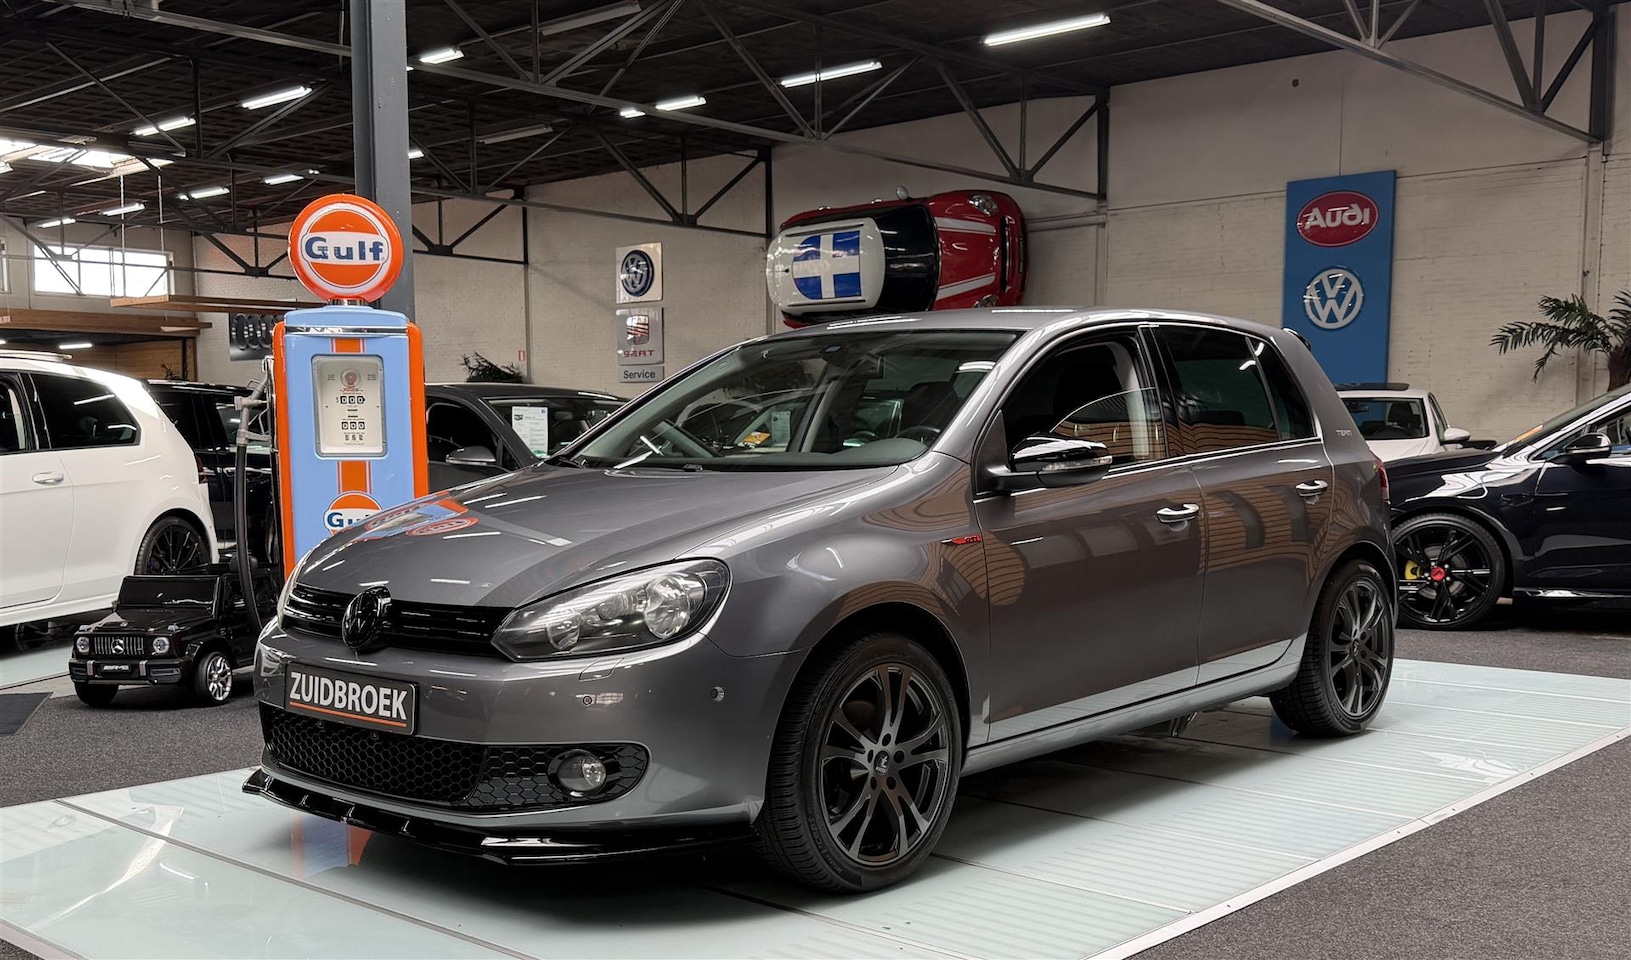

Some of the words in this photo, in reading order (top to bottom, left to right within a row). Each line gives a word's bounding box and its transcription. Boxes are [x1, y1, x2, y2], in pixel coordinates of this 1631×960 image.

[1304, 203, 1371, 230] Audi
[304, 236, 385, 262] Gulf
[623, 370, 656, 380] Service
[289, 671, 408, 720] ZUIDBROEK
